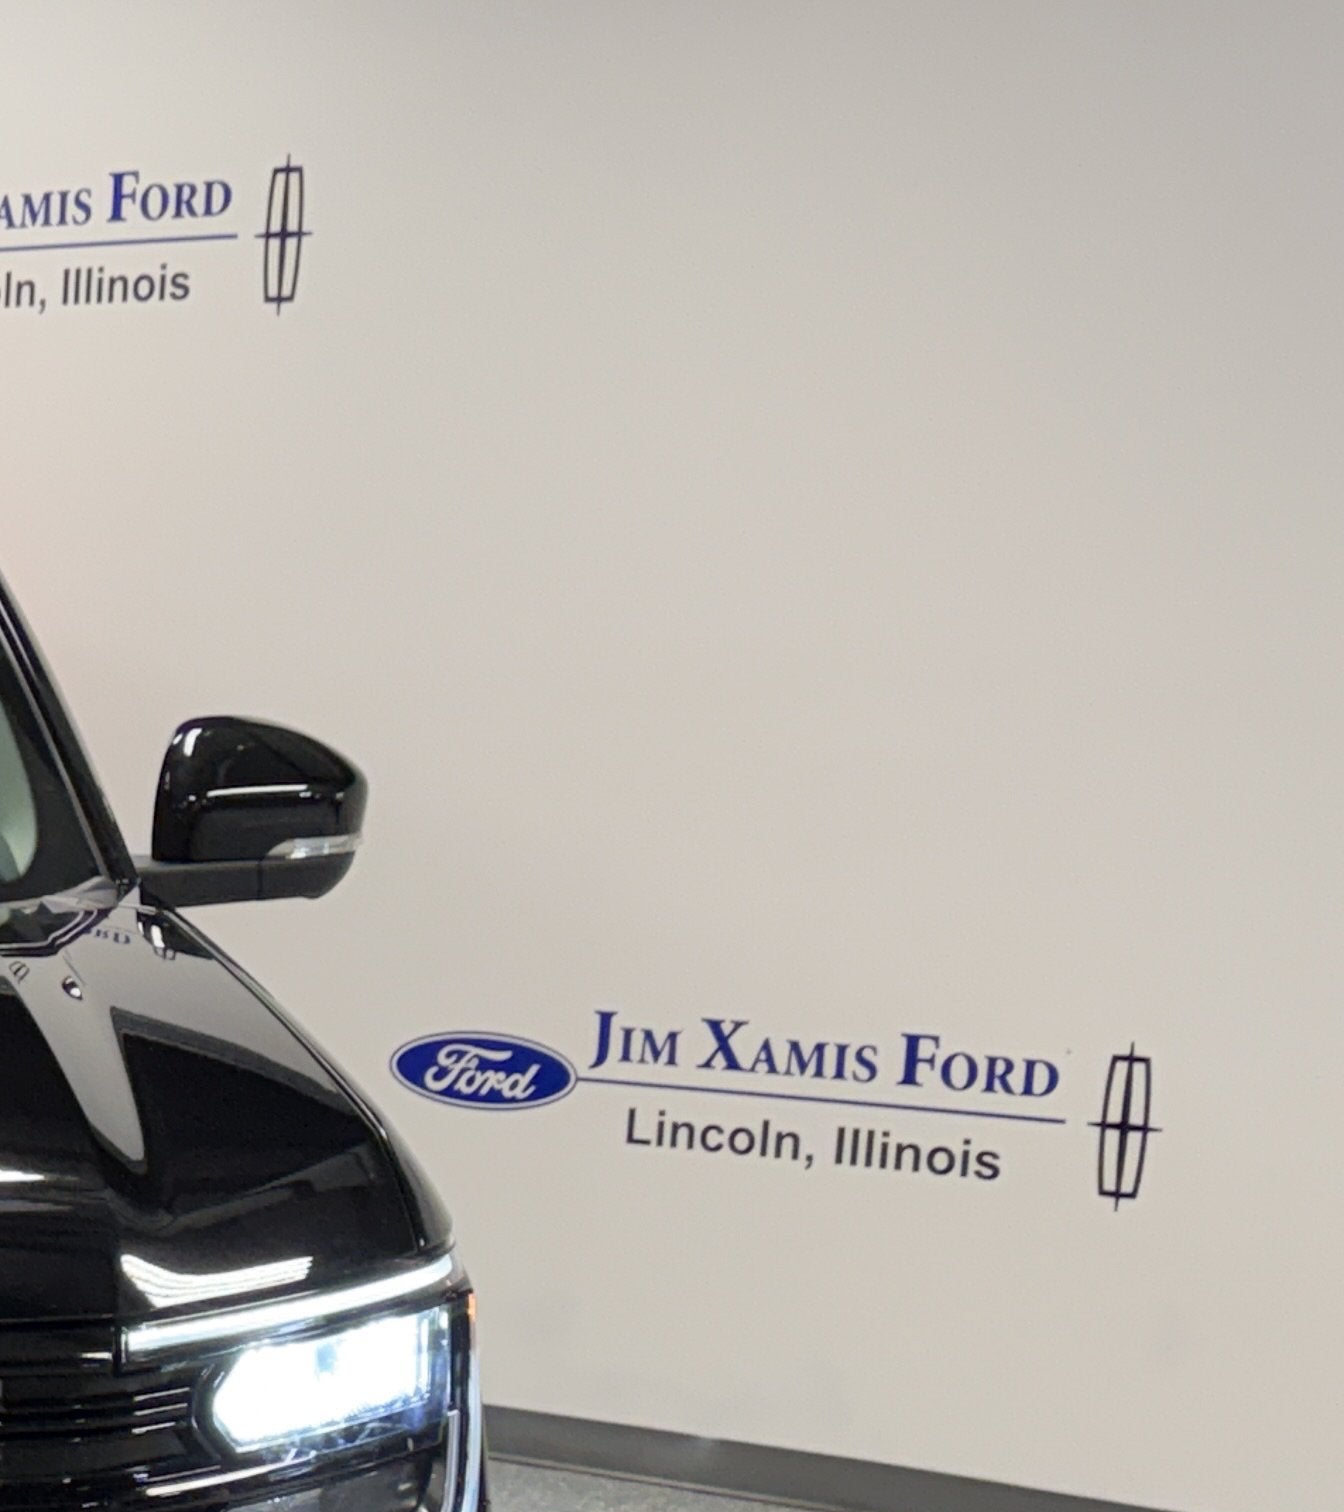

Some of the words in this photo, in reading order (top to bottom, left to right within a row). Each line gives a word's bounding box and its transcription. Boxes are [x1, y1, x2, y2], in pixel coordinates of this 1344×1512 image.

[106, 170, 233, 223] FORD
[61, 264, 191, 306] Illinois
[424, 1043, 538, 1101] Ford
[587, 1009, 684, 1070] JIM
[696, 1017, 879, 1085] XAMIS
[899, 1032, 1061, 1100] FORD
[625, 1107, 815, 1169] Lincoln,
[834, 1126, 1003, 1182] Illinois
